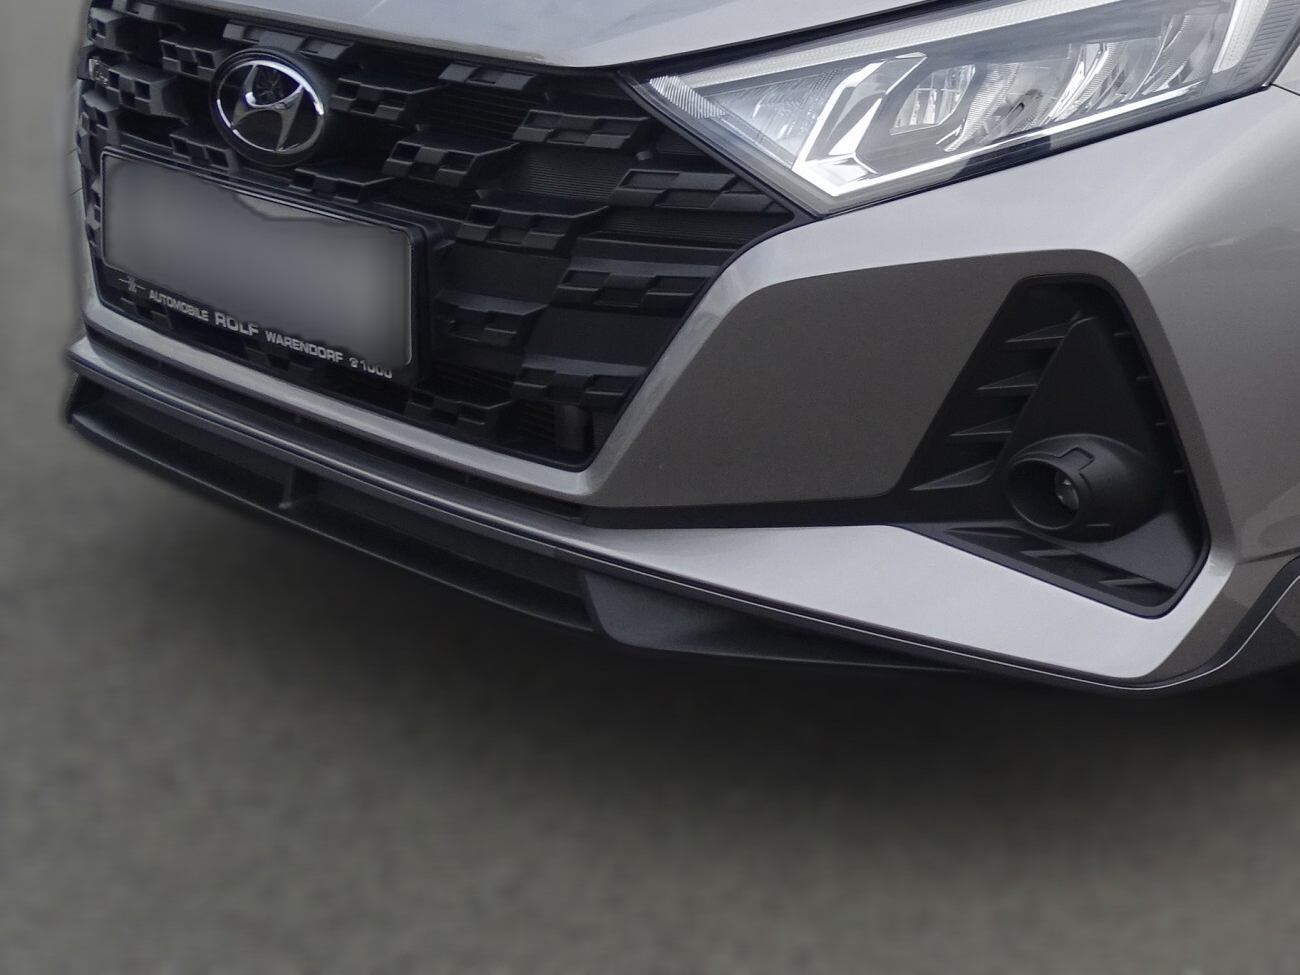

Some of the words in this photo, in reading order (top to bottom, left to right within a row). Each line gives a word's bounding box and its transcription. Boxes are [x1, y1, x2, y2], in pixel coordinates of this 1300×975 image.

[149, 289, 209, 322] AUTOMOBILE
[214, 311, 259, 336] ROLF
[265, 330, 343, 363] WARENDORF
